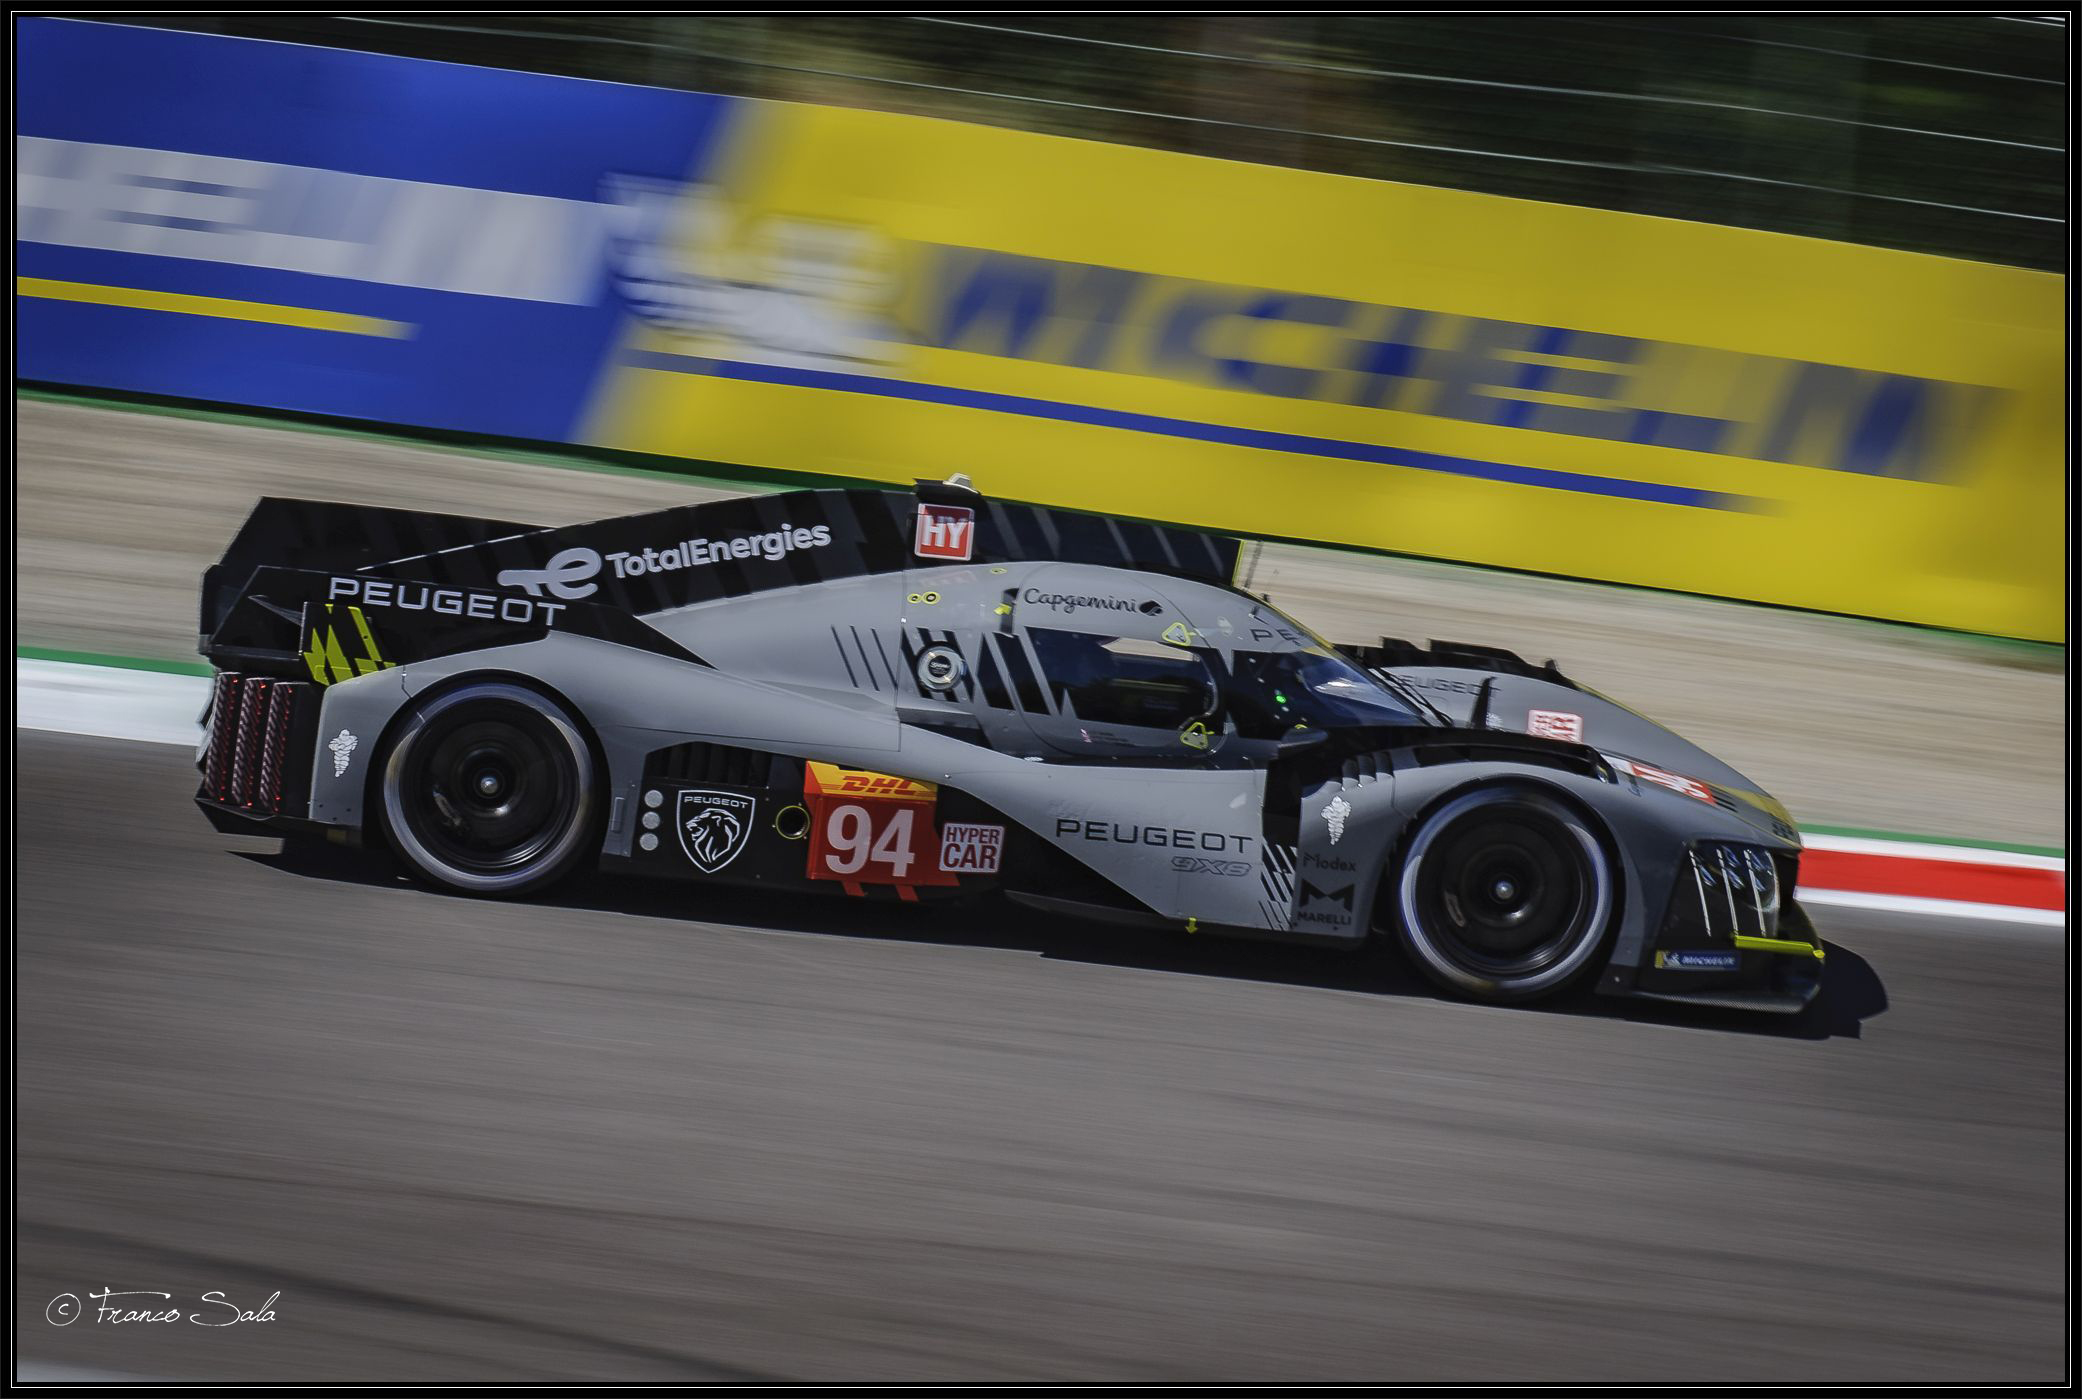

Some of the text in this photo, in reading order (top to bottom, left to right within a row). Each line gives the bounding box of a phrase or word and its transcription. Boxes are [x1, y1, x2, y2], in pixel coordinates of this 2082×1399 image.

[921, 515, 968, 549] HY
[605, 523, 832, 578] TotalEnergies
[328, 577, 566, 626] PEUGEOT
[1024, 588, 1137, 614] Capgemini
[840, 776, 917, 795] DHL
[684, 796, 748, 808] PEUGEOT
[825, 805, 915, 878] 94
[945, 827, 1000, 845] HYPER
[1056, 818, 1253, 853] PEUGEOT
[943, 844, 997, 869] CAR
[1297, 911, 1352, 925] MARELLI
